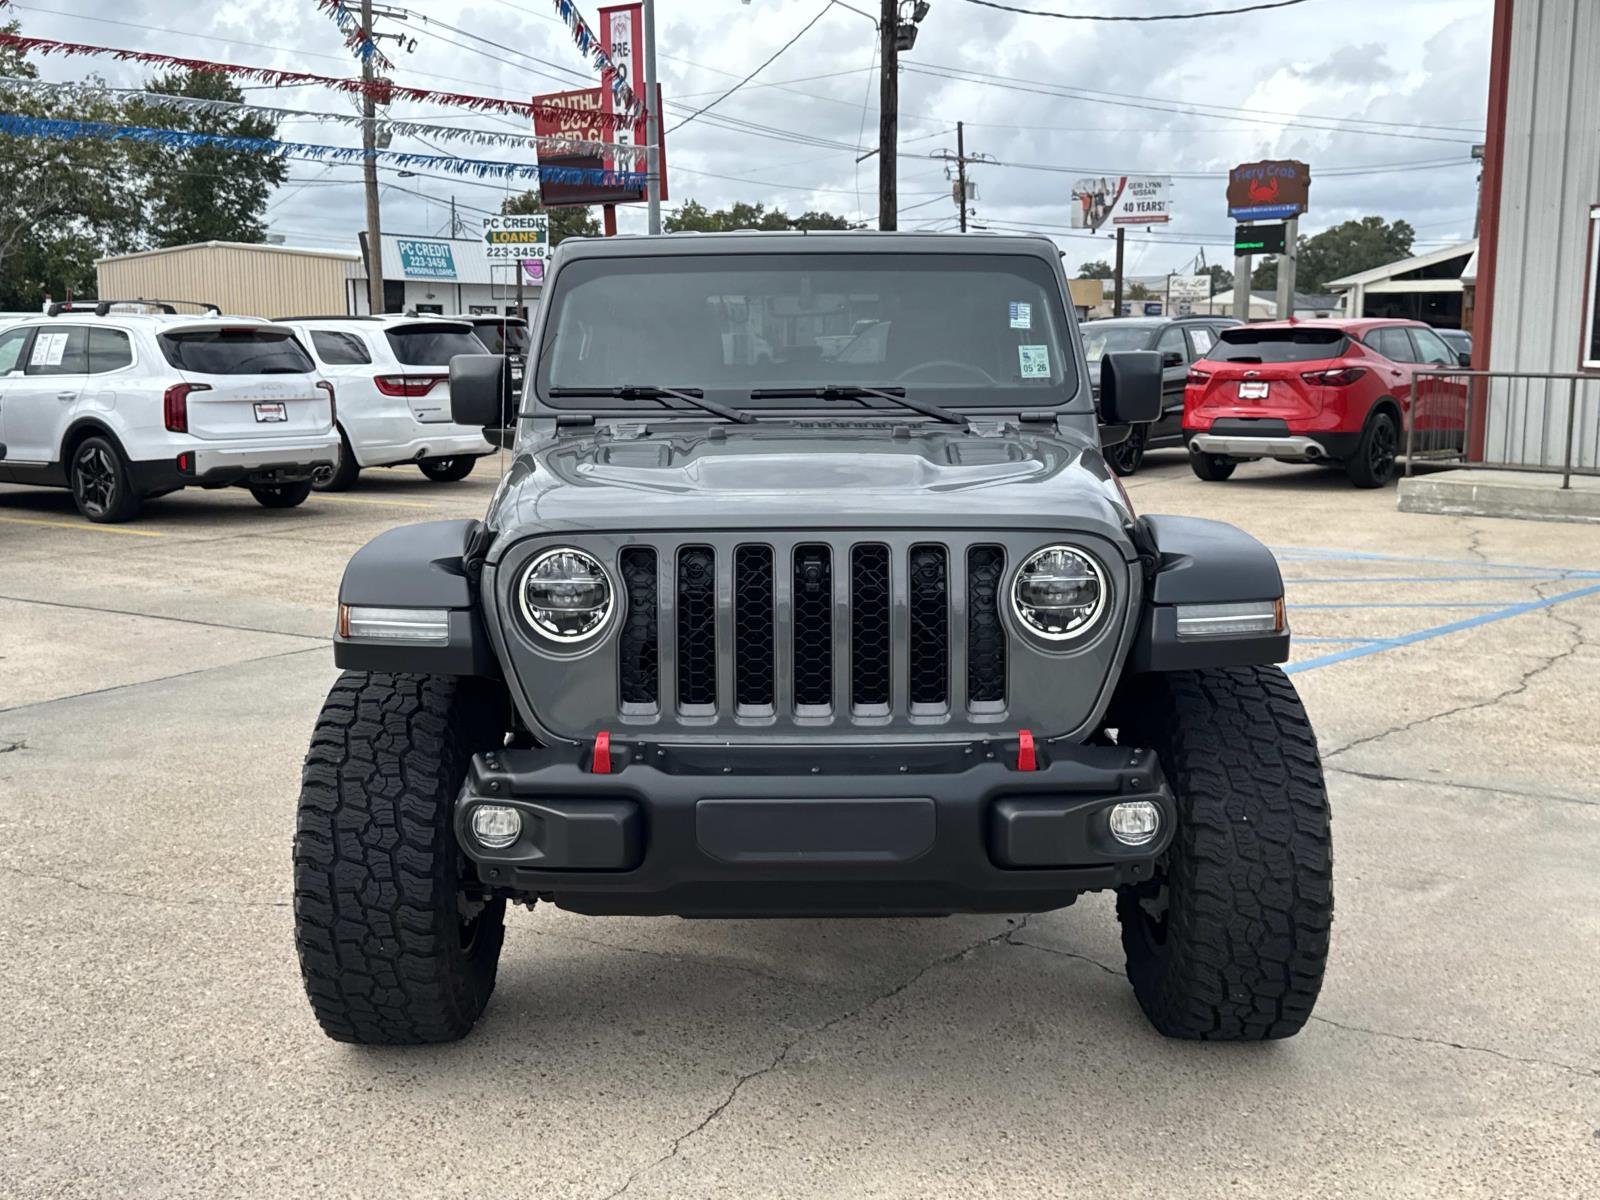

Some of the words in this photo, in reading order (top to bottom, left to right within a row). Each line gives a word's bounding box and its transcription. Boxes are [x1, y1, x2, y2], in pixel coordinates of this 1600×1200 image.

[612, 42, 630, 58] PRE-
[1266, 164, 1296, 178] Crab
[1122, 202, 1134, 212] 40
[482, 218, 499, 229] PC
[503, 217, 547, 229] CREDIT
[492, 231, 537, 242] LOANS
[399, 242, 414, 255] PC
[415, 243, 450, 258] CREDIT
[486, 247, 544, 257] 223-3456
[410, 256, 448, 268] 223-3456
[1023, 363, 1034, 373] 05
[1036, 363, 1047, 372] 26
